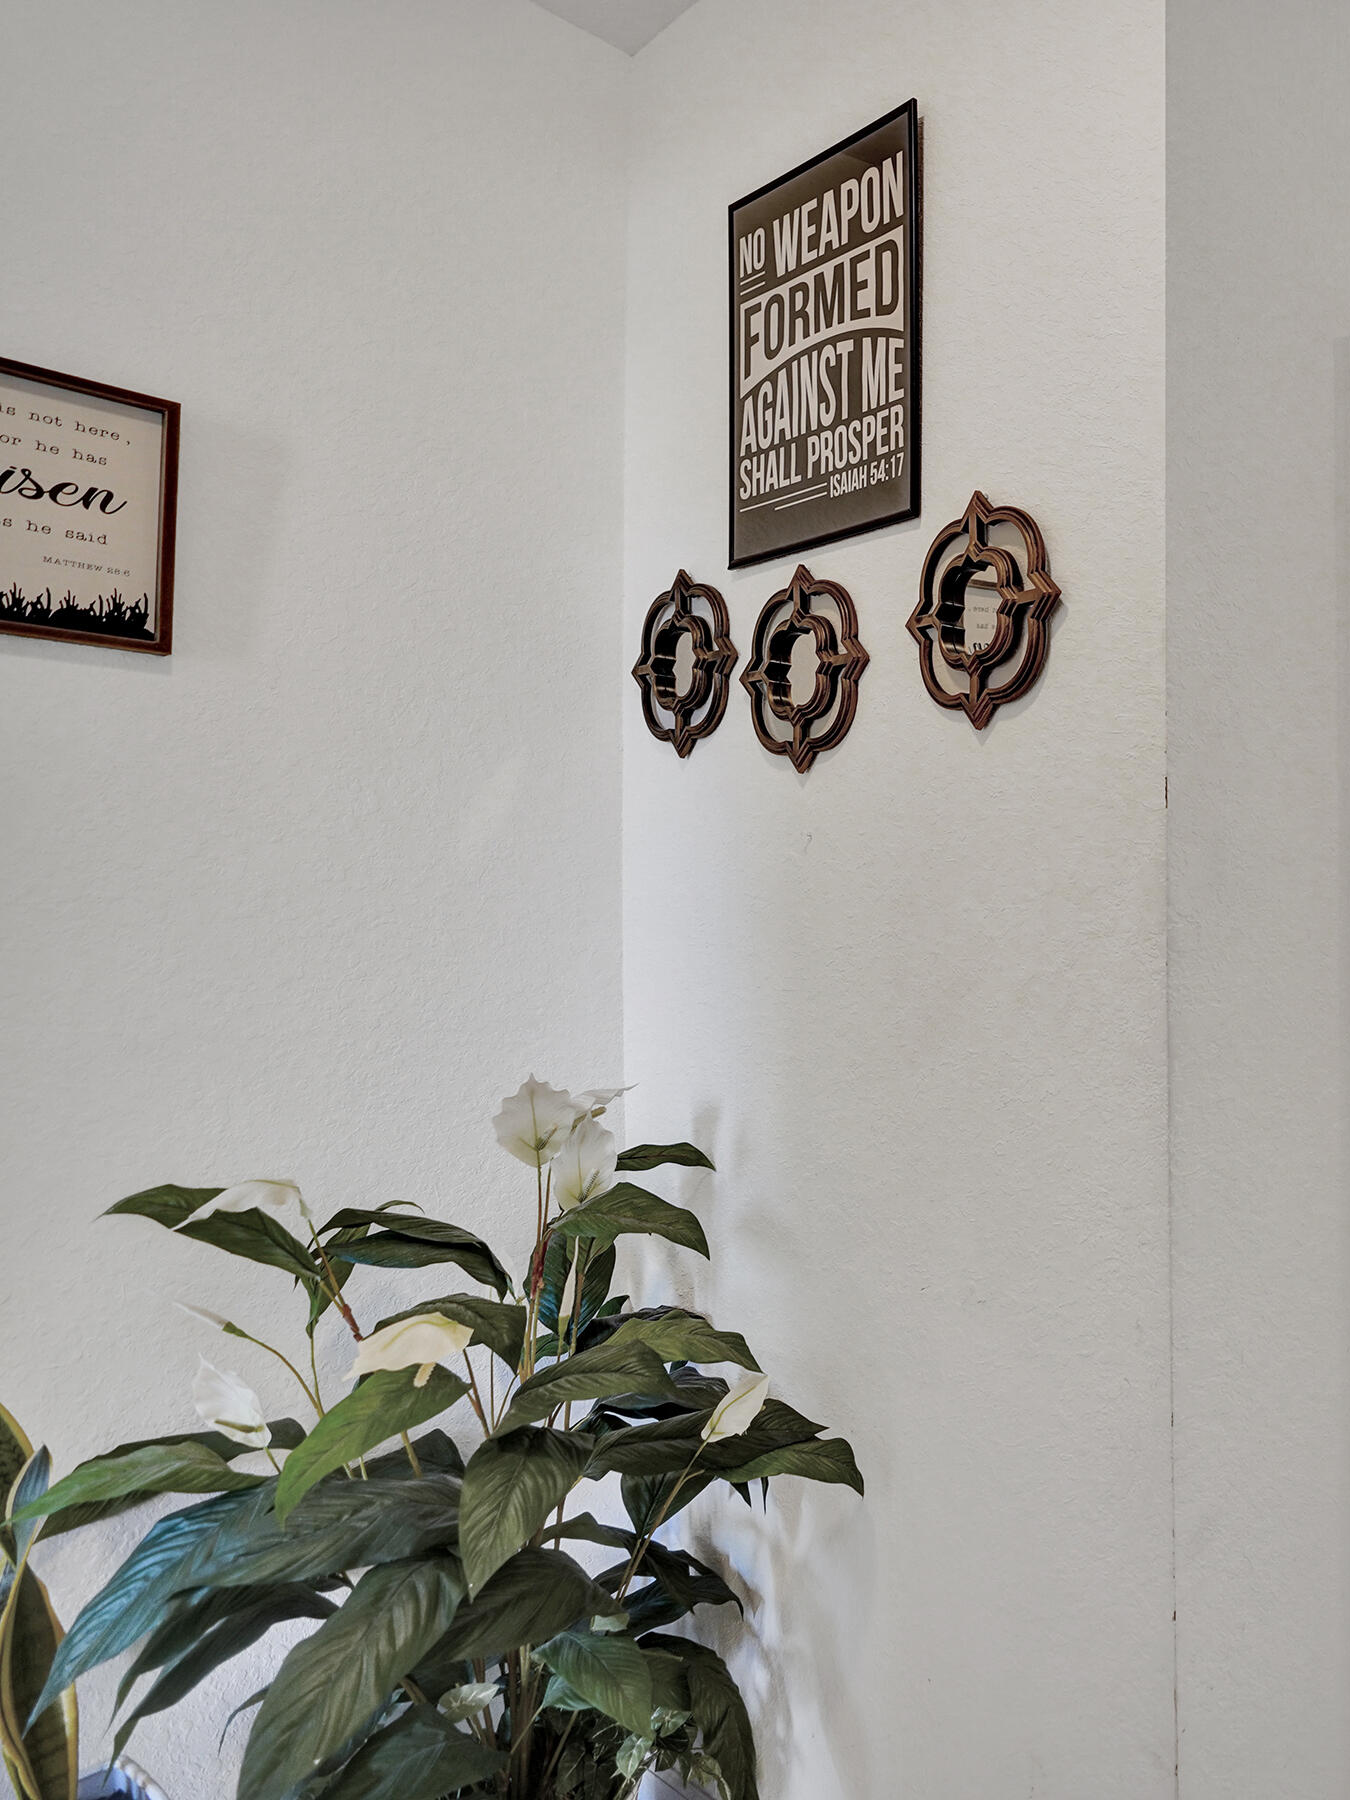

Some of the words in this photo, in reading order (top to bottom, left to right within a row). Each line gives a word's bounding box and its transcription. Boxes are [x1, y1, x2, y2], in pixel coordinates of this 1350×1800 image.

[739, 227, 766, 279] NO
[772, 150, 905, 278] WEAPON
[743, 237, 901, 384] FORMED
[739, 338, 855, 457] AGAINST
[861, 336, 905, 412] ME
[28, 410, 63, 428] not
[74, 420, 132, 446] here,
[35, 438, 60, 456] he
[72, 448, 108, 466] has
[739, 445, 801, 500] SHALL
[807, 404, 905, 476] PROSPER
[829, 465, 868, 499] ISAIAH
[869, 455, 905, 486] 54:17
[26, 519, 52, 535] he
[65, 529, 108, 546] said
[42, 555, 103, 572] MATTHEW
[106, 567, 131, 577] 286
